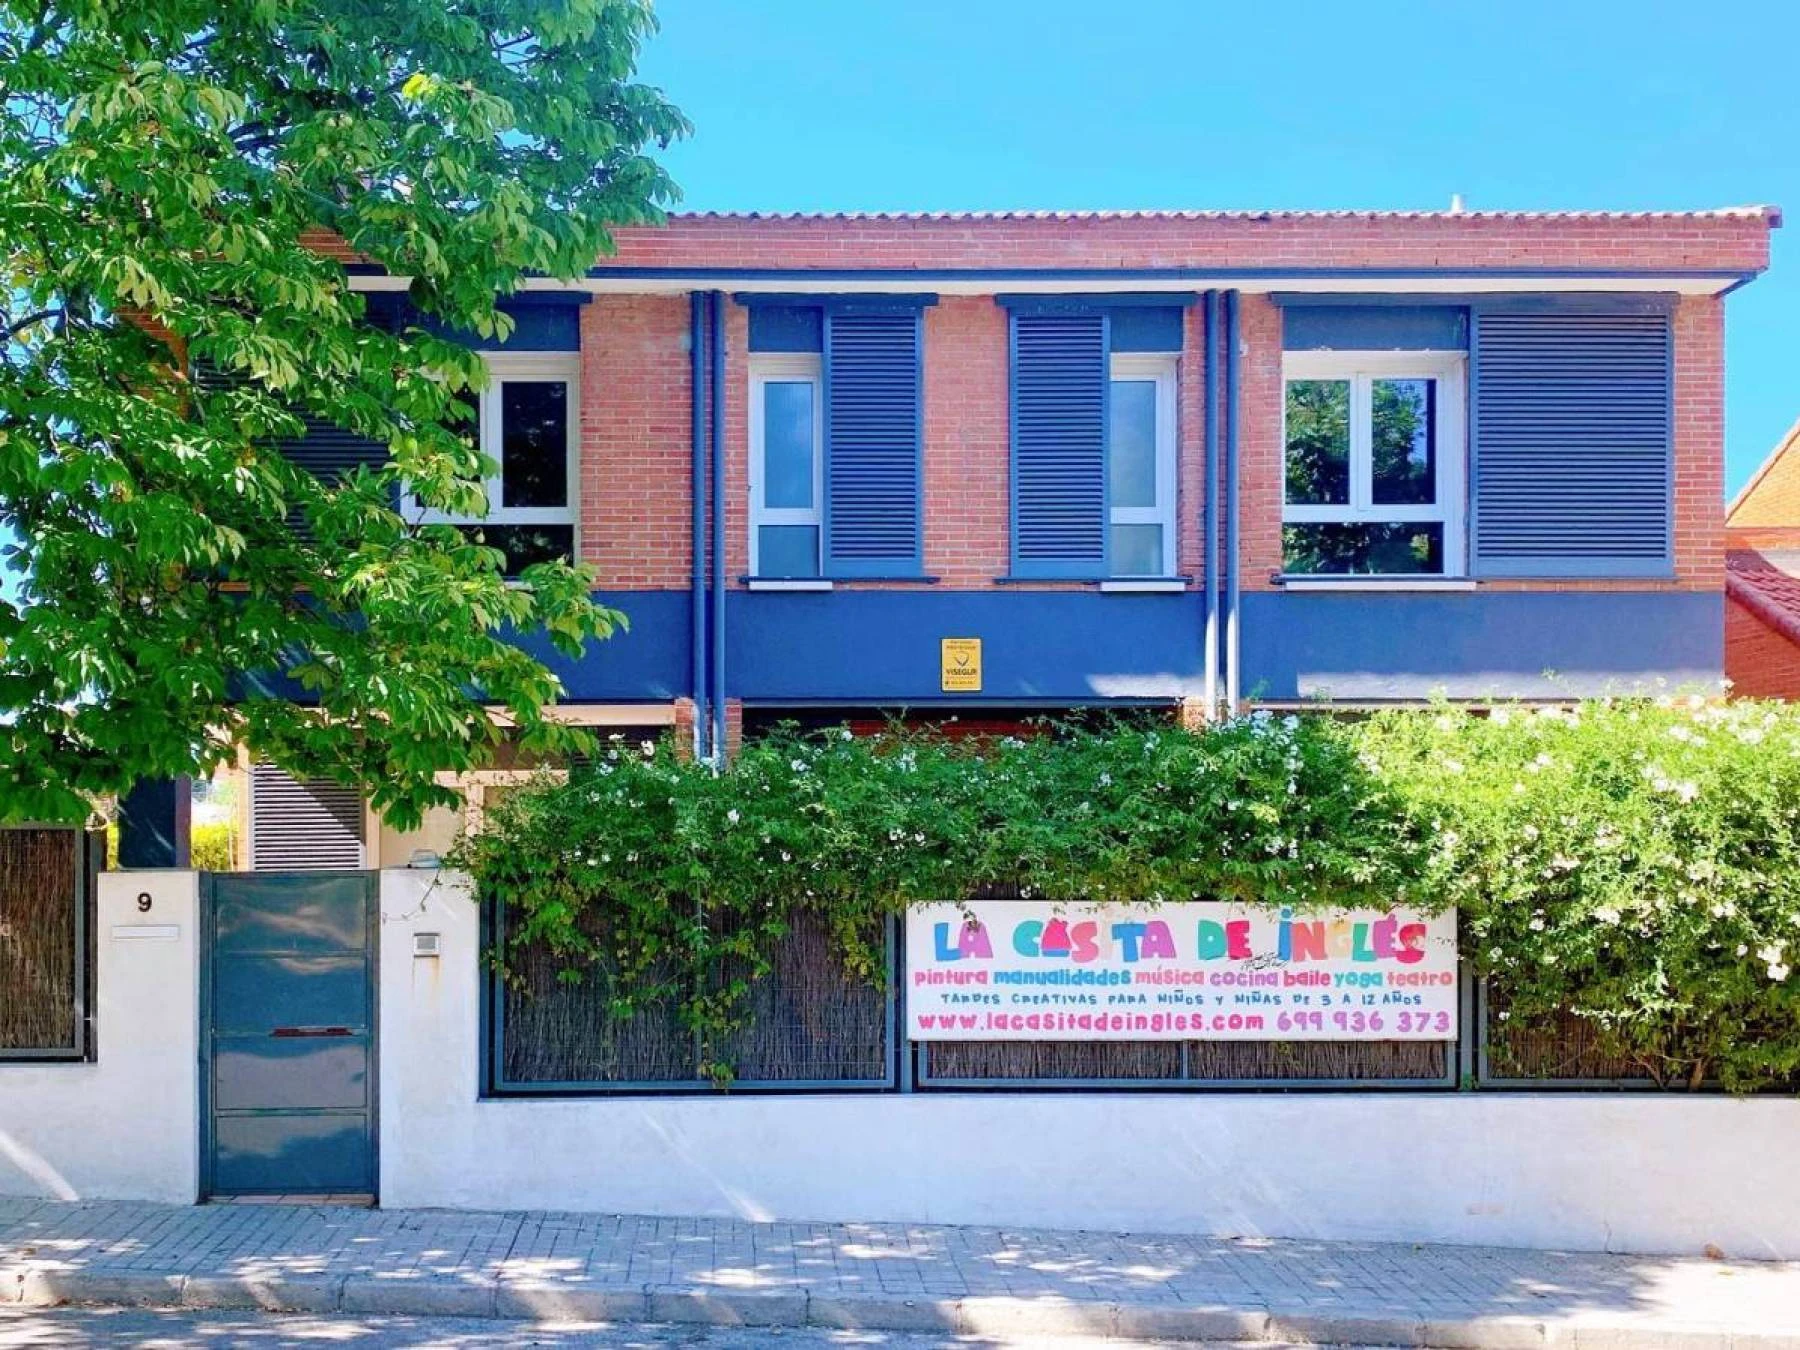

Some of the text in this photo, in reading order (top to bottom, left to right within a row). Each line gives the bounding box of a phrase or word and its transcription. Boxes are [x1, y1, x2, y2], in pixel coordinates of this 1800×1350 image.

[137, 892, 153, 912] 9
[934, 919, 994, 961] LA
[1198, 919, 1252, 961] DE
[914, 965, 1453, 988] pintura manualidades música cocina baile yoga teatro
[1011, 993, 1097, 1005] CREATIVAS
[1108, 993, 1147, 1005] PARA
[1157, 989, 1204, 1005] NIÑOS
[1235, 990, 1282, 1005] NIÑAS
[1342, 994, 1351, 1005] A
[1362, 994, 1376, 1005] 12
[1382, 990, 1422, 1005] AÑOS
[917, 1011, 1450, 1032] www.lacasitadeingles.com 699 936 373
